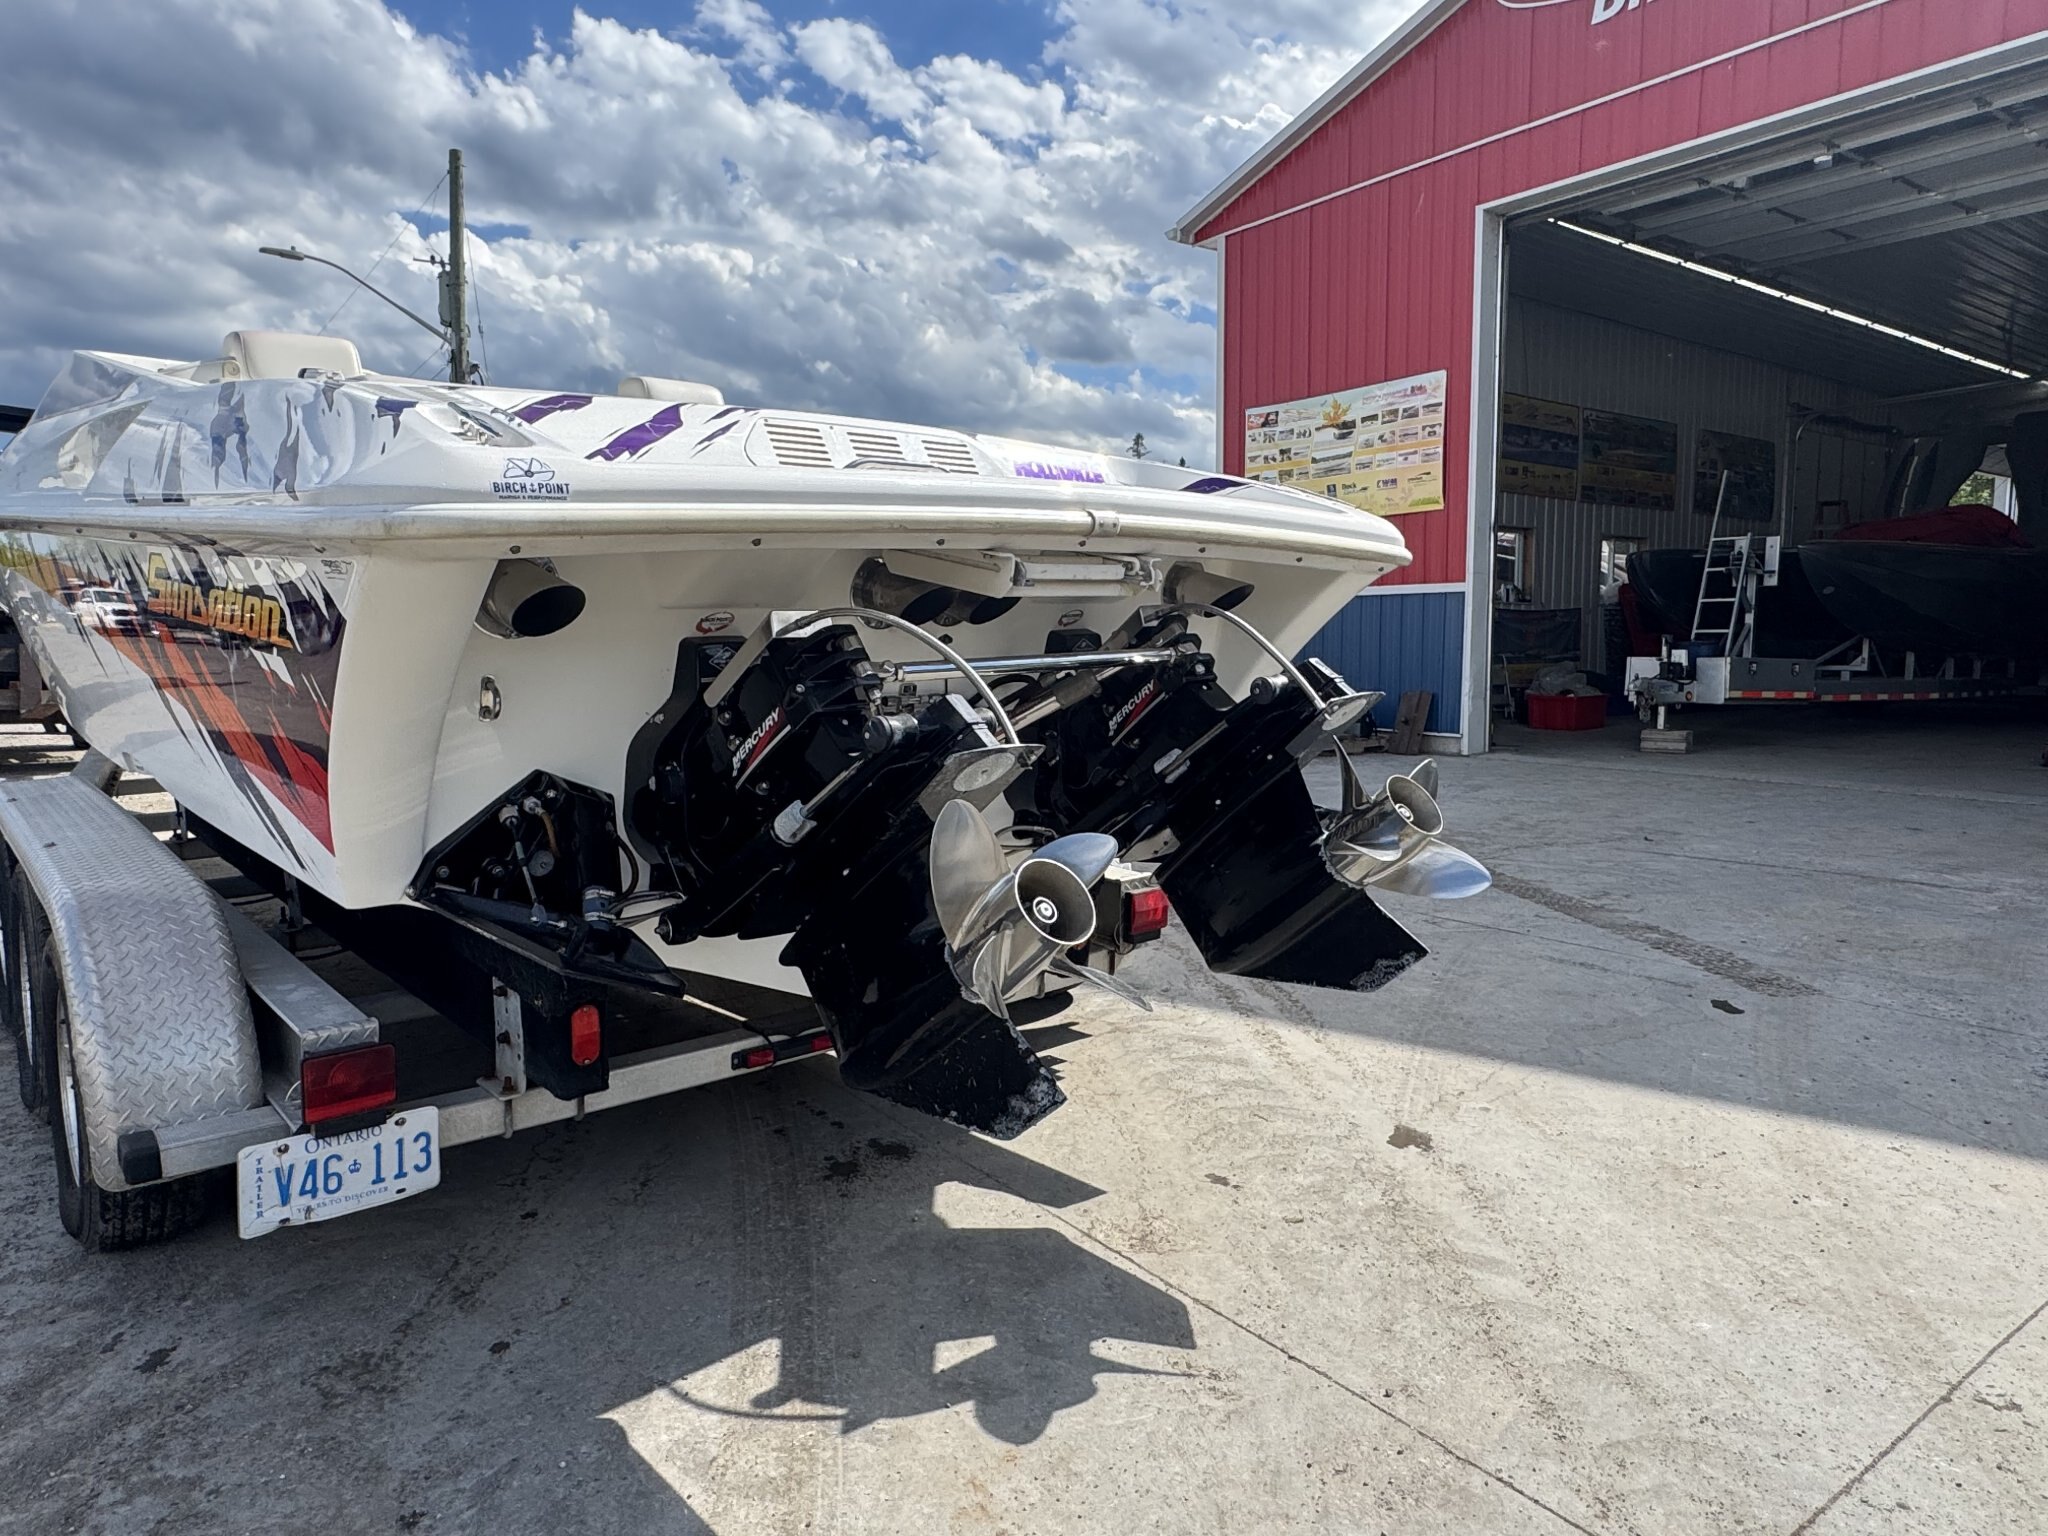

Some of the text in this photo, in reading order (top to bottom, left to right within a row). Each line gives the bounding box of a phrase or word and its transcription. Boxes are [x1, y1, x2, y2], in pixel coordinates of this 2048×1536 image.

[493, 482, 570, 494] BIRCH POINT
[1108, 679, 1155, 736] MERCURY
[732, 706, 780, 777] MERCURY
[304, 1125, 382, 1154] ONTARIO
[255, 1157, 265, 1219] TRAILER
[274, 1131, 432, 1208] V46 113
[345, 1186, 389, 1201] DISCOVER
